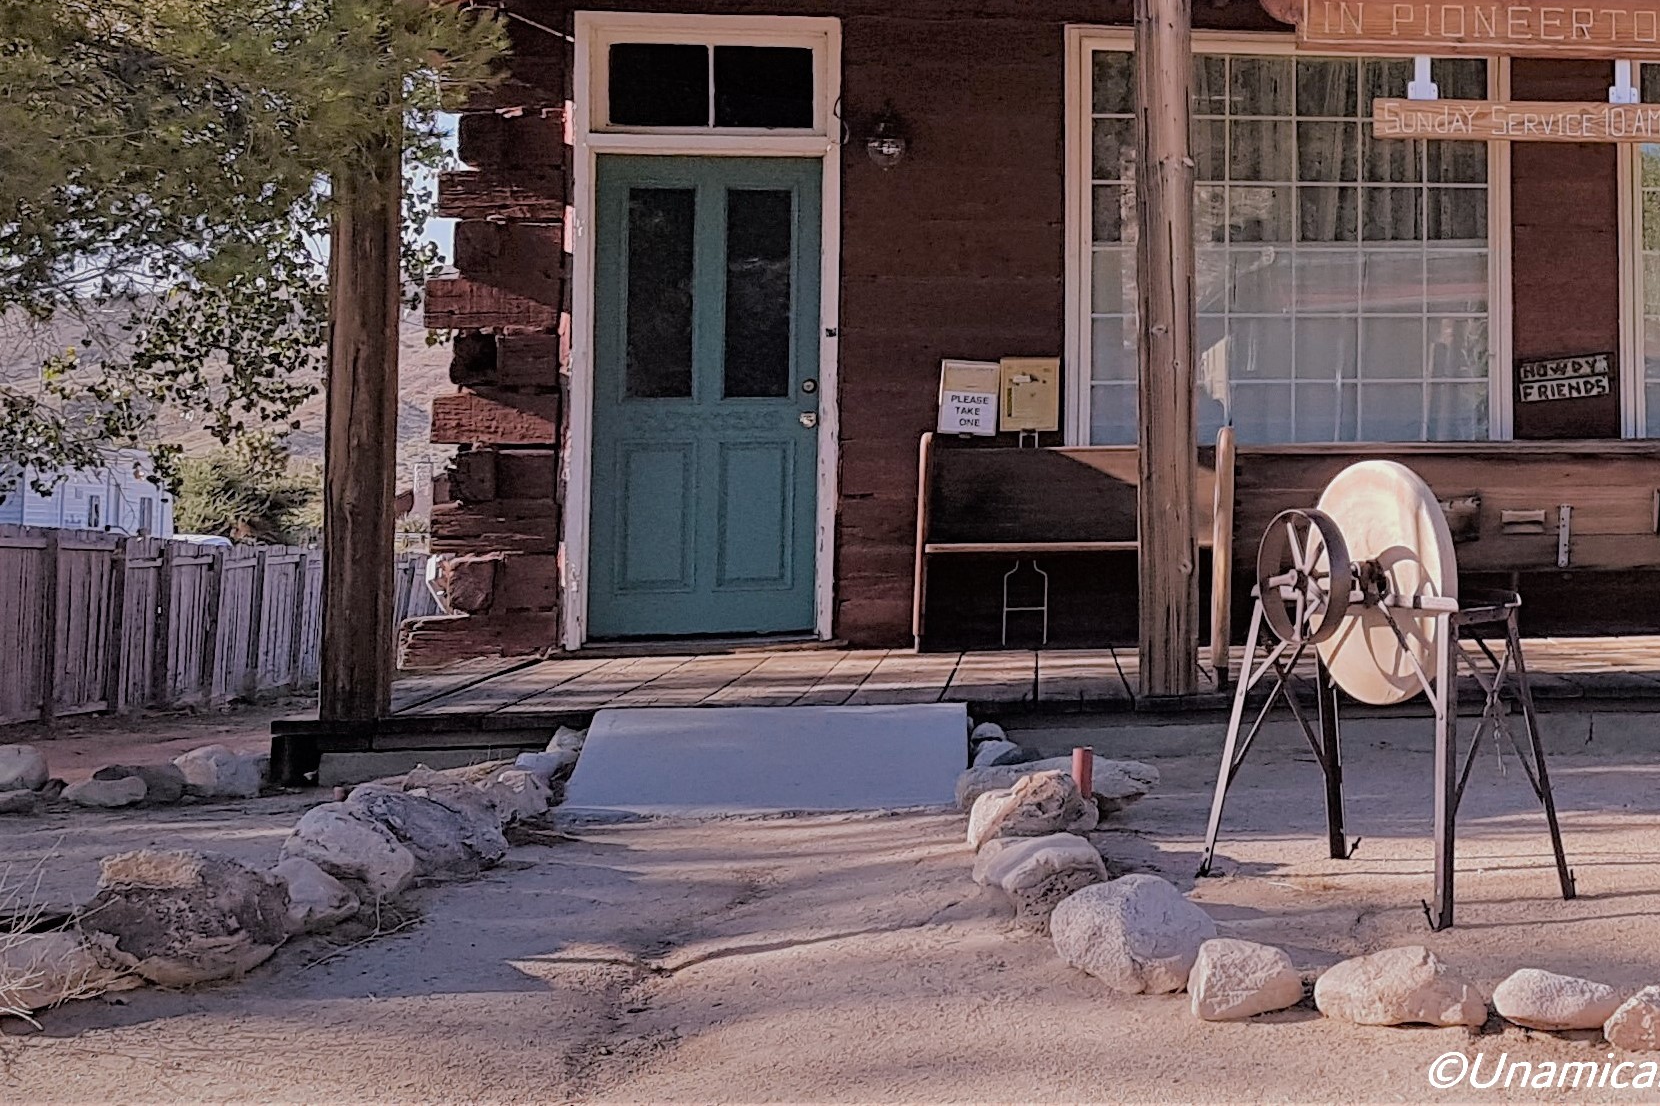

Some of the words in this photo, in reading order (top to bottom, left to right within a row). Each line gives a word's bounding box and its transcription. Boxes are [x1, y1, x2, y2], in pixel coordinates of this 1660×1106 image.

[1321, 0, 1365, 35] IN
[1491, 105, 1598, 137] SERVICE
[1601, 107, 1626, 137] 10
[1522, 378, 1606, 401] FRIENDS
[950, 394, 990, 405] PLEASE
[955, 406, 981, 416] TAKE
[958, 417, 981, 427] ONE
